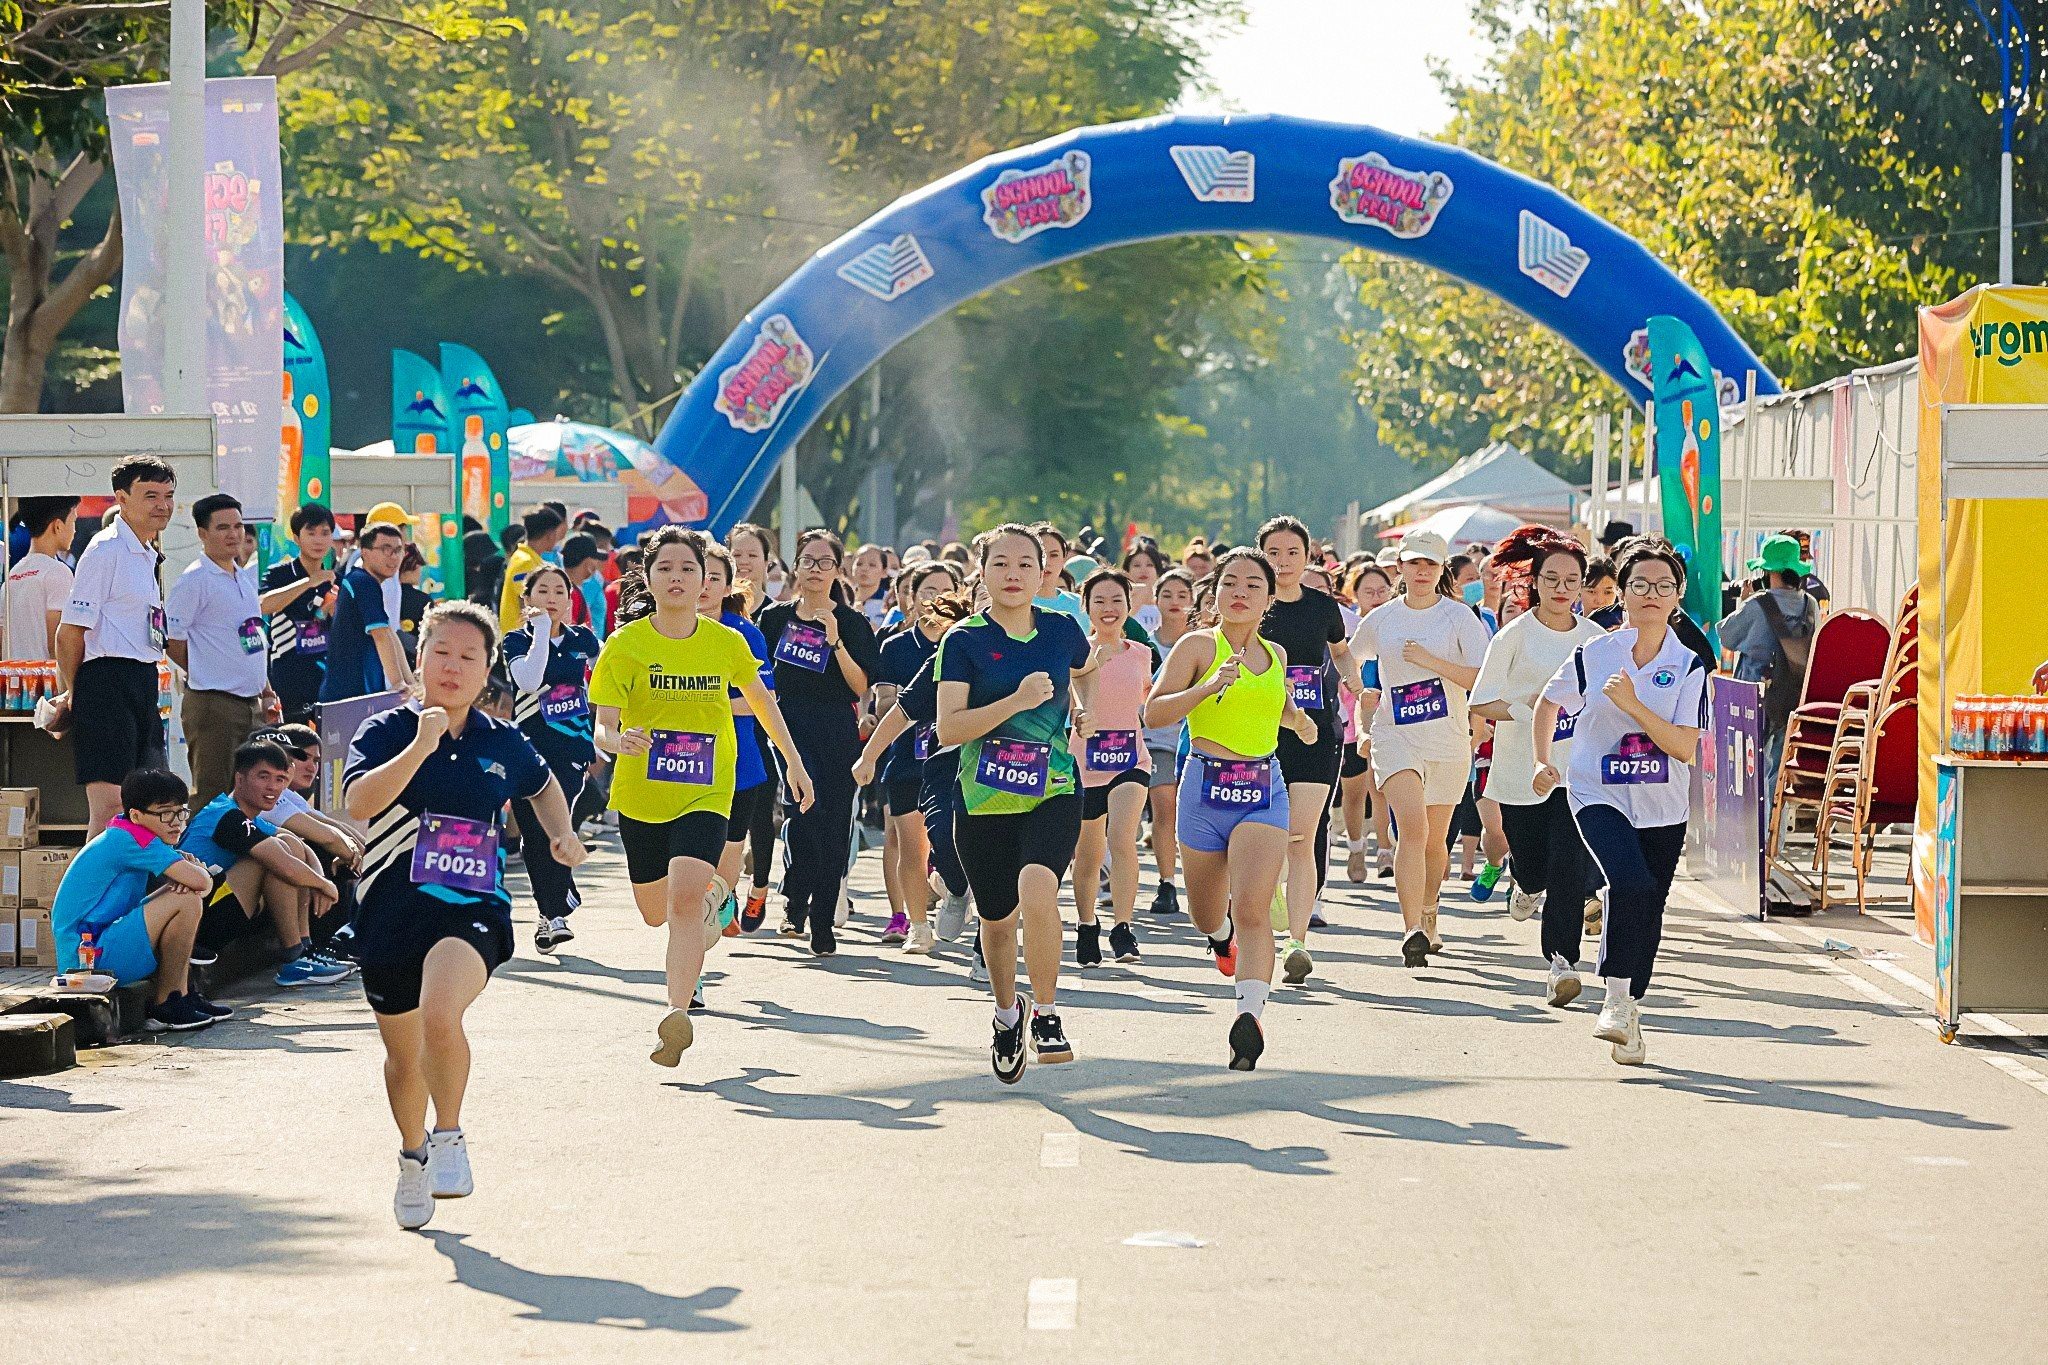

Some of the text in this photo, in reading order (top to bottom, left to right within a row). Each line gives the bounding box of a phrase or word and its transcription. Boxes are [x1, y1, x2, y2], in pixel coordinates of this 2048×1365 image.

[996, 169, 1075, 209] SCHOOL
[1351, 162, 1426, 211] SCHOOL
[1017, 200, 1060, 229] FEST
[1356, 194, 1404, 228] FEST
[724, 339, 790, 408] SCHOOL
[783, 642, 821, 664] F1066
[649, 673, 720, 690] VIETNAM MTB
[649, 689, 720, 702] VOLUNTEER
[547, 697, 581, 715] F0934
[1400, 700, 1441, 718] F0816
[656, 757, 704, 774] F0011
[1093, 751, 1131, 763] F0907
[1610, 759, 1660, 775] F0750
[986, 761, 1038, 786] F1096
[1210, 785, 1262, 803] F0859
[424, 851, 487, 878] F0023
